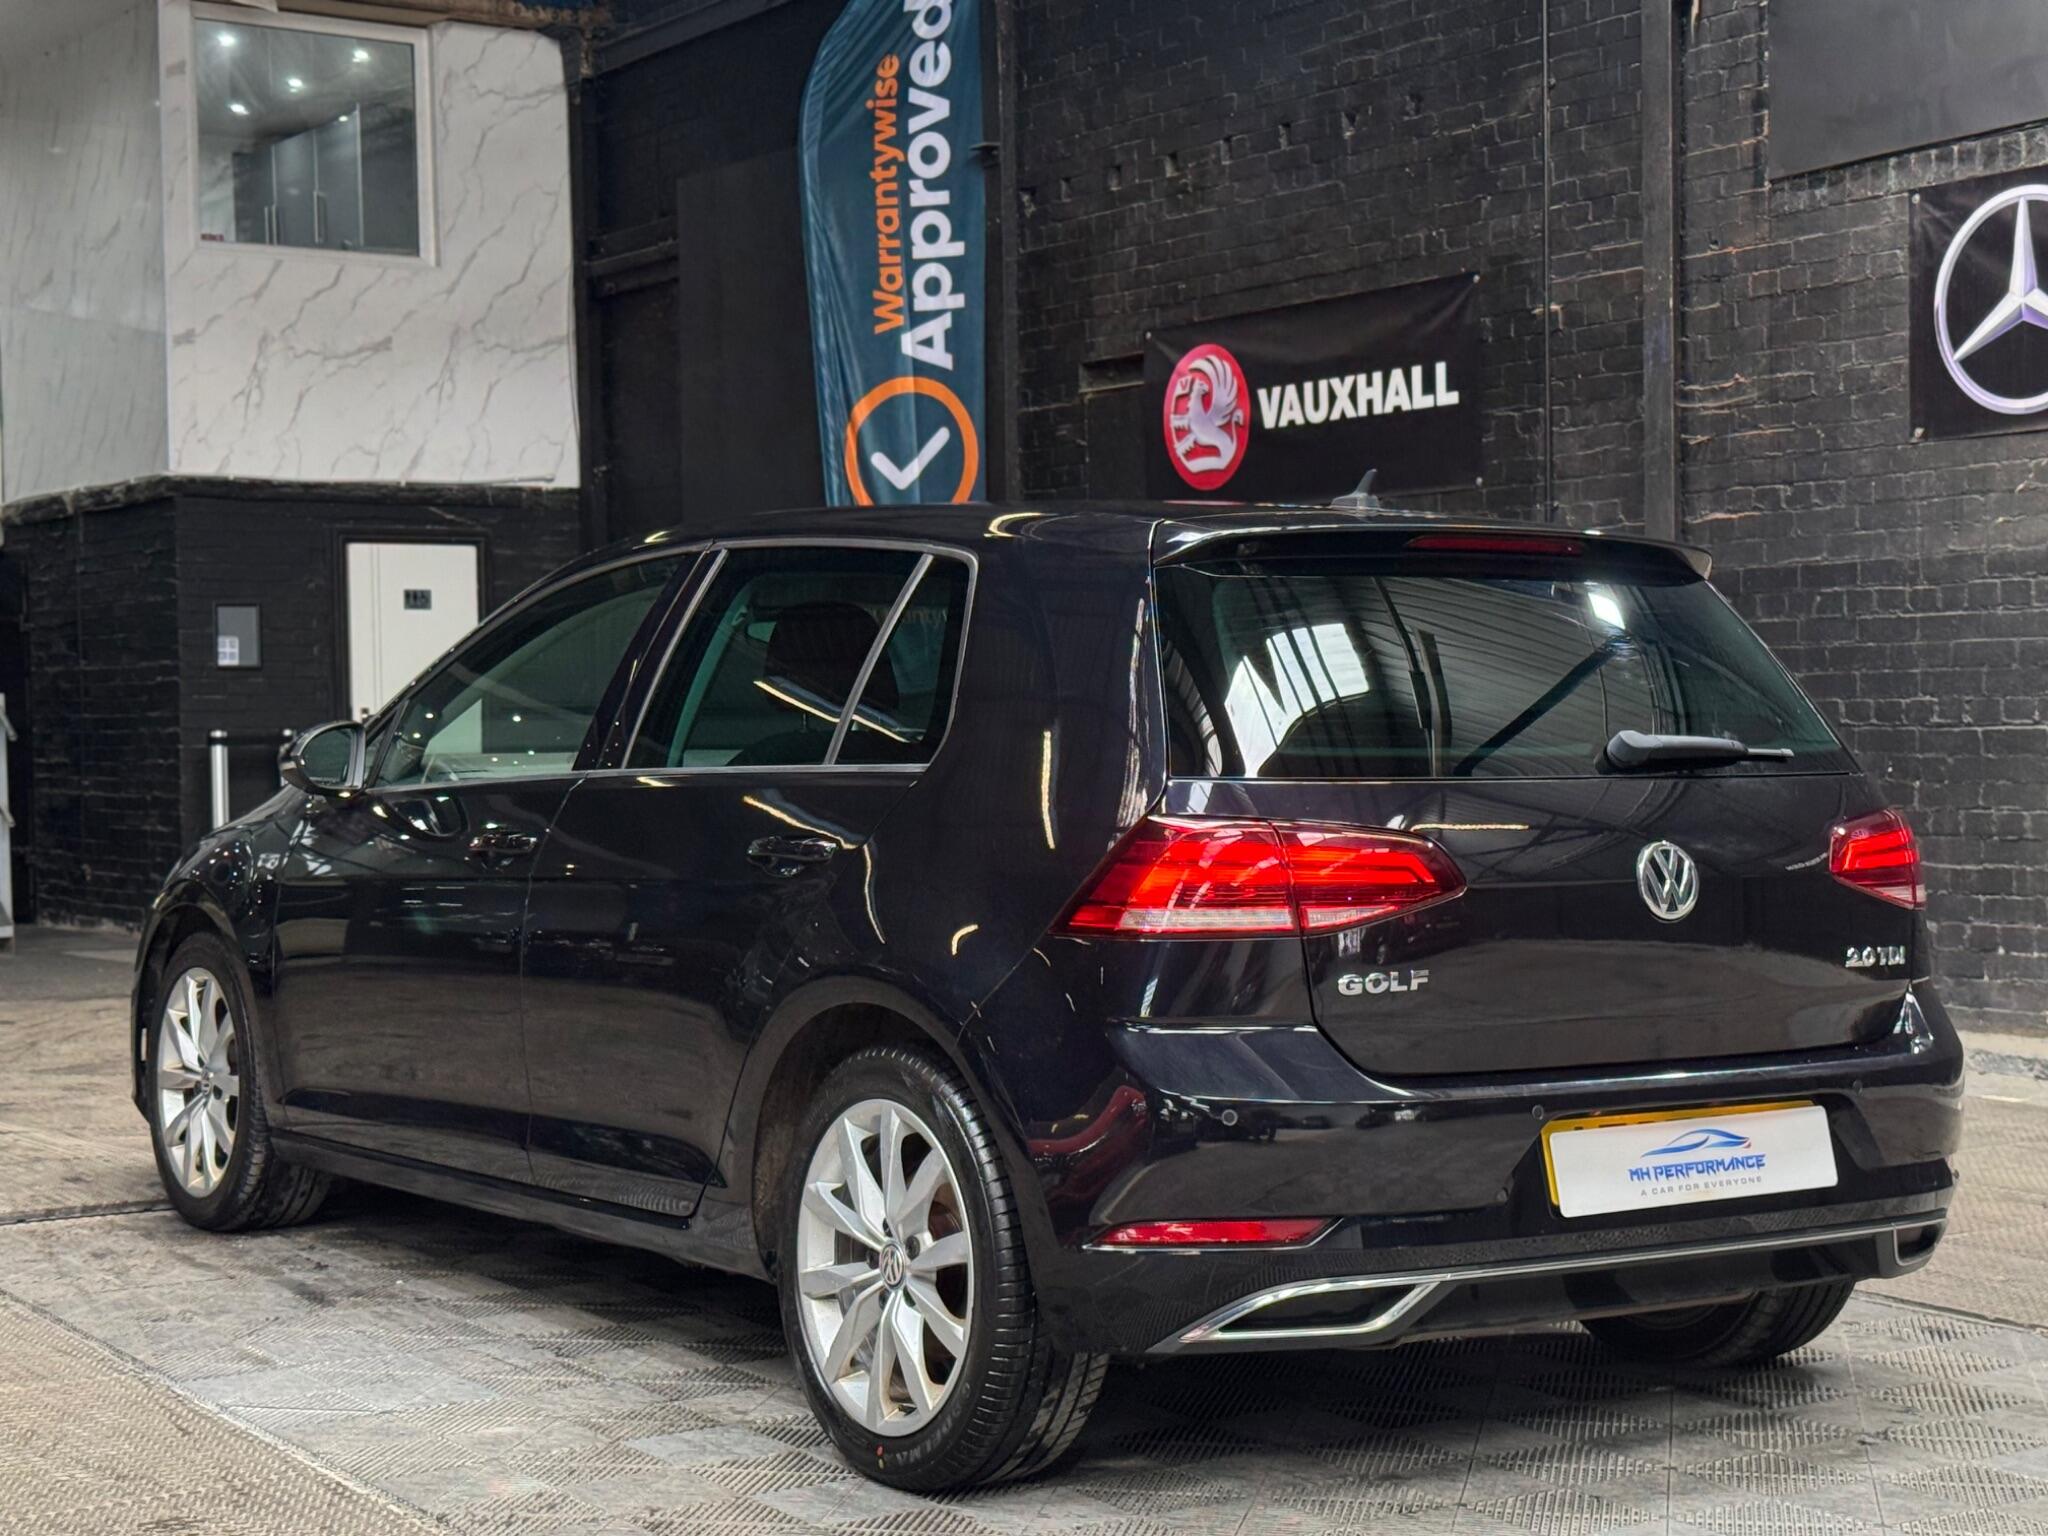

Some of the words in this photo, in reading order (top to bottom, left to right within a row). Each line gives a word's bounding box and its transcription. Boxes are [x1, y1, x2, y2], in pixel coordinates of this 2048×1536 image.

[866, 53, 905, 335] Warrantywise
[901, 0, 965, 371] Approved
[1257, 361, 1459, 429] VAUXHALL
[1337, 969, 1429, 996] GOLF
[1629, 1168, 1651, 1182] MH
[1653, 1154, 1766, 1181] PERFORMANCE
[1651, 1185, 1674, 1195] CAR
[1678, 1182, 1700, 1192] FOR
[1703, 1175, 1763, 1189] EVERYONE
